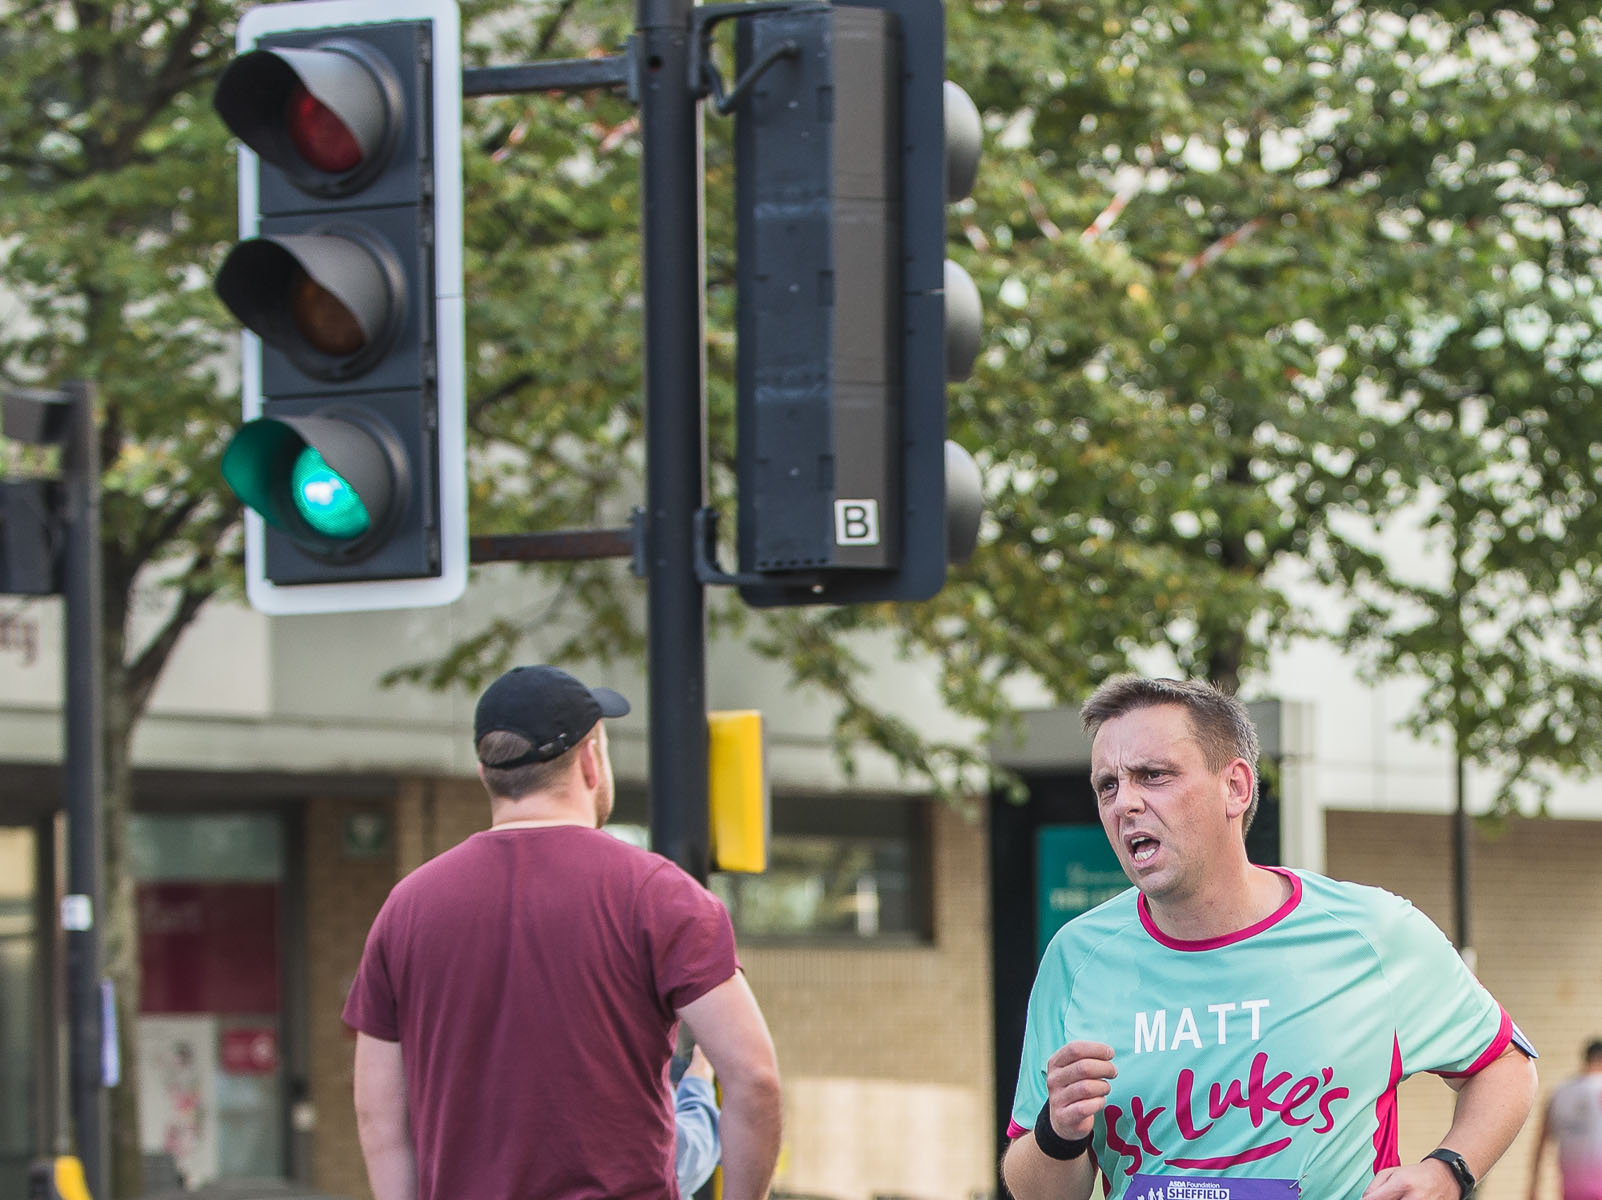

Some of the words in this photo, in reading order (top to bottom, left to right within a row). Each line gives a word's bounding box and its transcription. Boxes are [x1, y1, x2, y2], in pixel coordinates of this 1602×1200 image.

[844, 506, 868, 539] B
[1134, 999, 1270, 1054] MATT
[1175, 1052, 1349, 1141] Luke's
[1168, 1188, 1228, 1200] SHEFFIELD
[1186, 1181, 1220, 1189] Foundation
